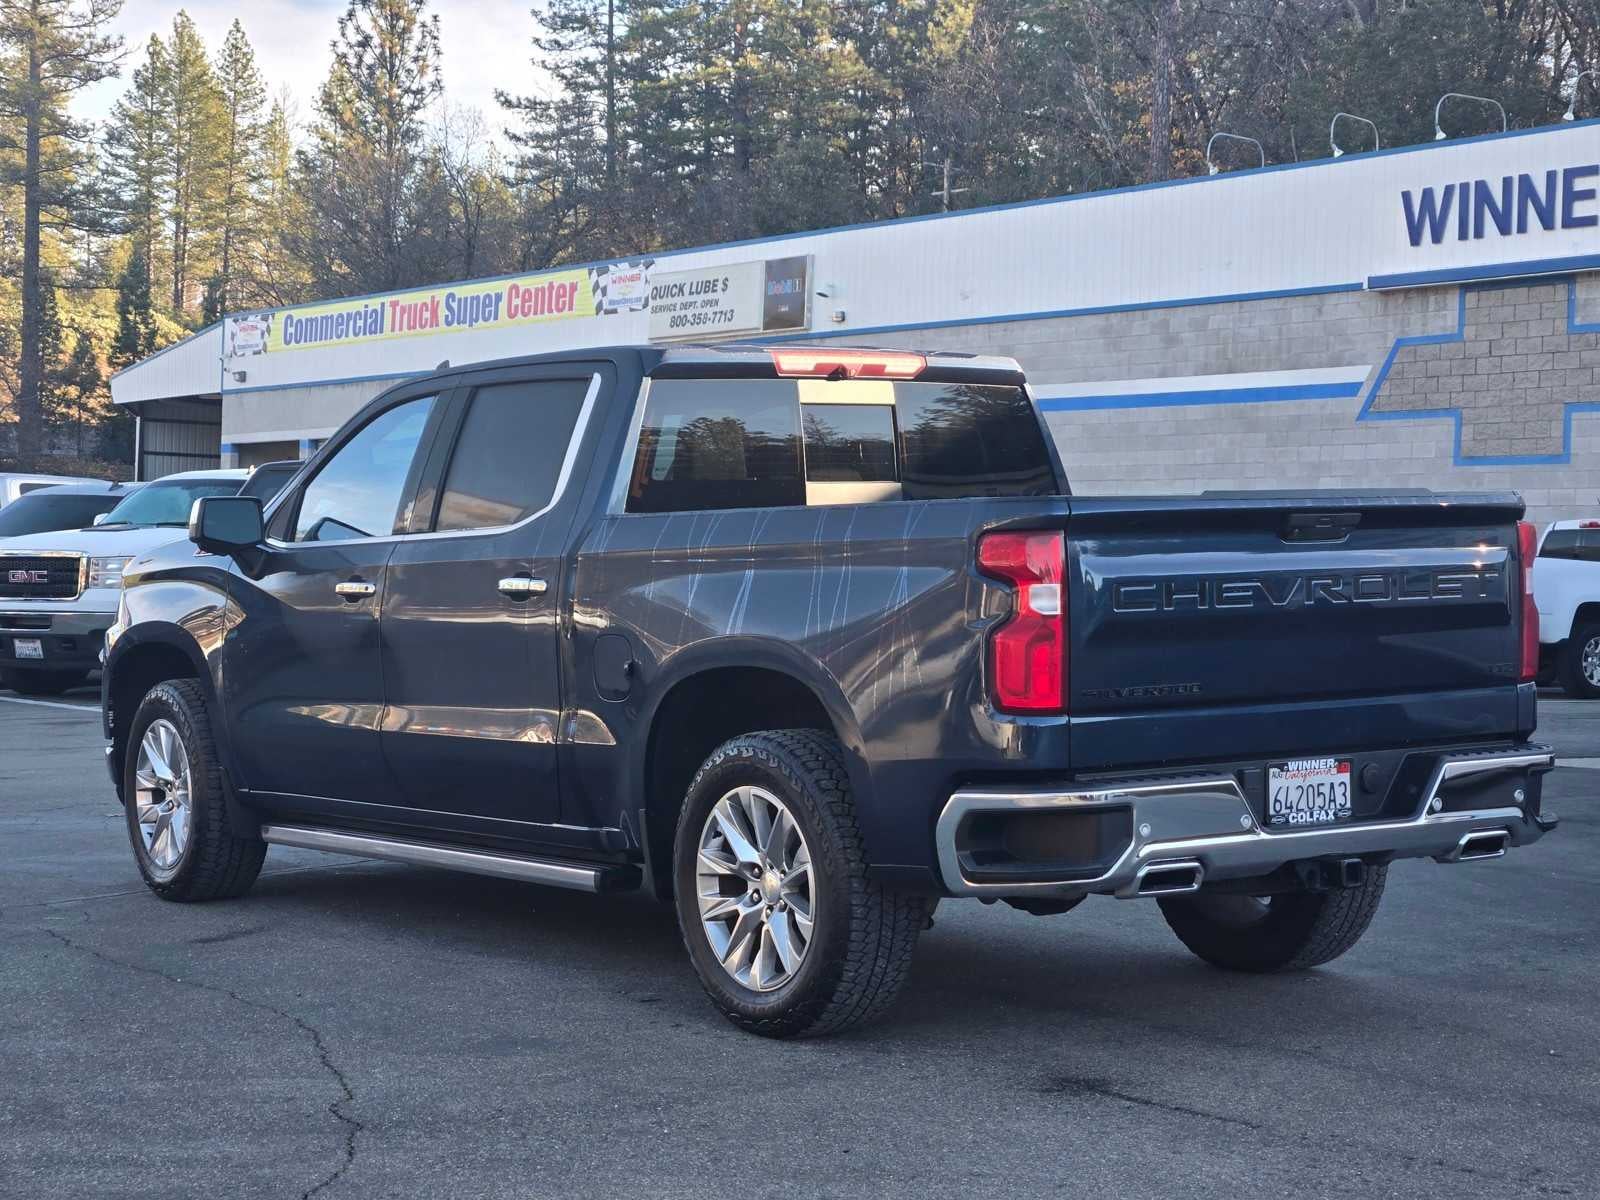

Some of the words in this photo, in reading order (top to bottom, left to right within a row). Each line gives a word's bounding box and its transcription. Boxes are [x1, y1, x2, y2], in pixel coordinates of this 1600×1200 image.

[1401, 164, 1600, 247] WINNE
[650, 282, 687, 300] QUICK
[688, 278, 719, 295] LUBE
[283, 302, 386, 346] Commercial
[389, 295, 440, 333] Truck
[444, 291, 503, 327] Super
[506, 280, 579, 322] Center
[650, 303, 677, 314] SERVICE
[679, 301, 698, 310] DEPT.
[700, 298, 719, 309] OPEN
[669, 309, 734, 328] 800-358-7713
[9, 570, 48, 583] GMC
[1113, 569, 1499, 613] CHEVROLET
[1287, 758, 1336, 772] WINNER
[1273, 780, 1348, 815] 64205A3
[1288, 809, 1336, 824] COLFAX
